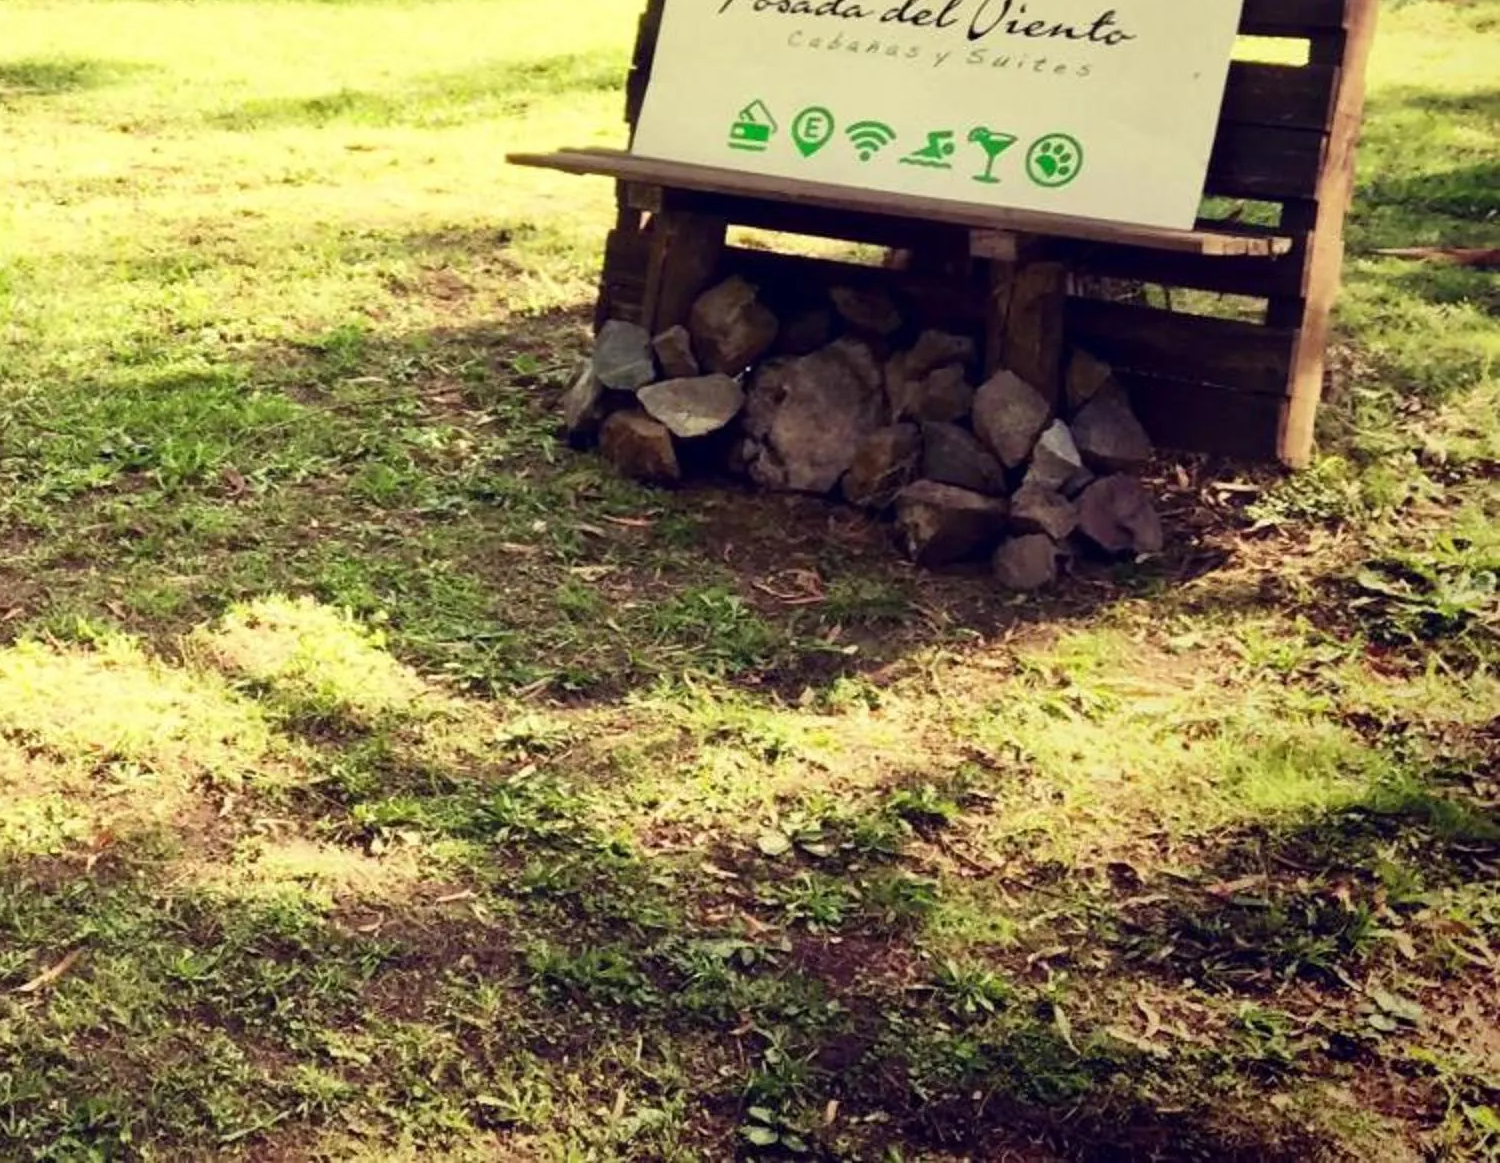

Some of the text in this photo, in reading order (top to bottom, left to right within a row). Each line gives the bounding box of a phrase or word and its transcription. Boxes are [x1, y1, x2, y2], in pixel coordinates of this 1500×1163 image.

[932, 50, 951, 68] y
[965, 48, 1093, 78] Suites
[803, 116, 824, 138] E
